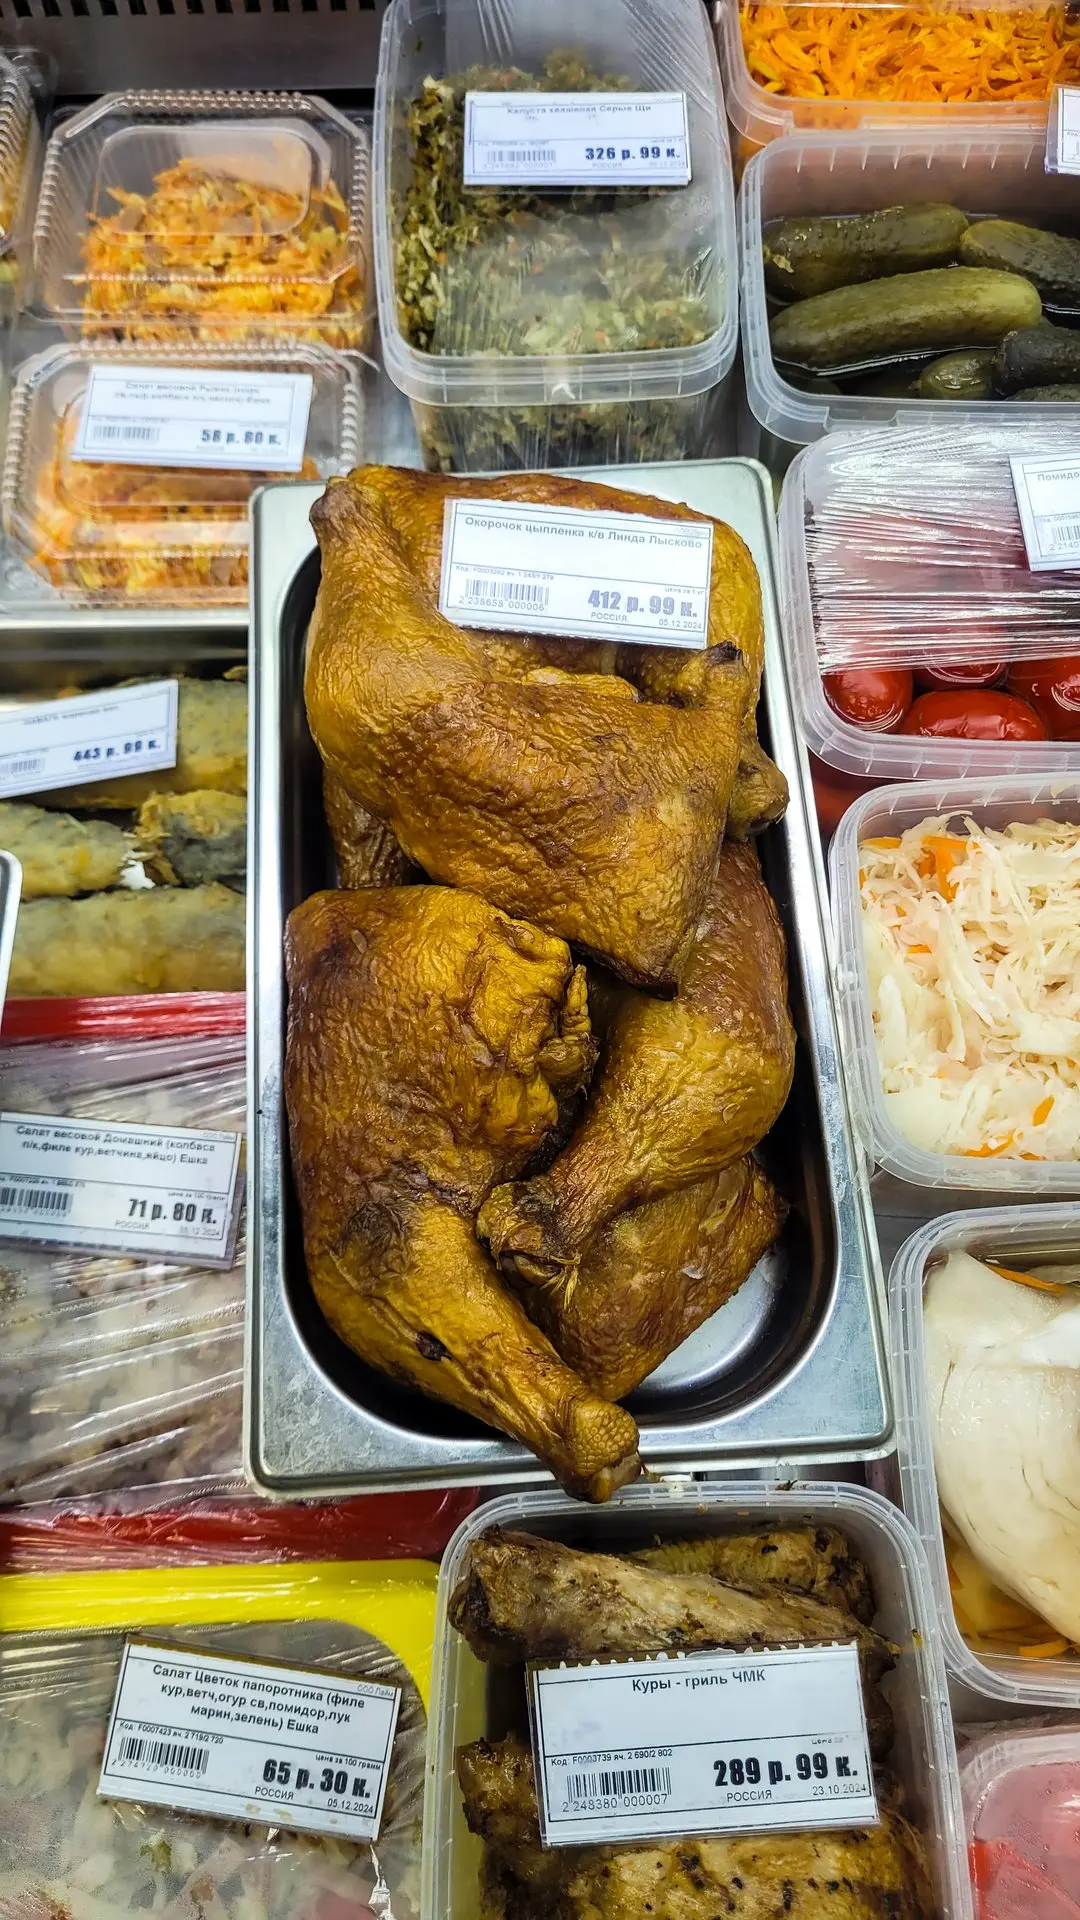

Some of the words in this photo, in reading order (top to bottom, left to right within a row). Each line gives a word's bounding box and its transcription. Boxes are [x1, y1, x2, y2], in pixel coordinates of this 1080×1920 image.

[585, 147, 616, 160] 326
[621, 149, 636, 160] р.
[640, 146, 661, 159] 99
[666, 147, 681, 158] к.
[465, 516, 522, 531] Окорочок
[525, 523, 584, 538] цыпленка
[588, 530, 605, 540] к/в
[608, 531, 645, 544] Линда
[649, 535, 702, 549] Лысково
[459, 596, 465, 604] 2
[588, 590, 621, 610] 412
[626, 596, 644, 613] р.
[649, 595, 674, 616] 99
[680, 601, 697, 618] к.
[591, 611, 628, 622] РОССИЯ
[659, 618, 702, 629] 05.12.2024
[16, 1125, 51, 1137] Салат
[54, 1130, 101, 1142] весовой
[104, 1132, 163, 1147] Домашний
[166, 1139, 216, 1152] (колбаса
[180, 1153, 209, 1165] Ешка
[128, 1198, 148, 1218] 71
[151, 1203, 168, 1221] р.
[173, 1202, 197, 1223] 80
[201, 1208, 218, 1225] к.
[153, 1664, 192, 1680] Салат
[195, 1670, 240, 1688] Цветок
[242, 1680, 323, 1702] папоротника
[326, 1692, 365, 1709] (филе
[632, 1678, 671, 1694] Куры
[685, 1675, 728, 1690] гриль
[732, 1668, 766, 1683] ЧМК
[161, 1683, 247, 1708] кур,ветч,огур
[250, 1699, 351, 1724] св,помидор,лук
[190, 1705, 284, 1731] марин,зелень)
[287, 1718, 319, 1734] Ешка
[315, 1754, 334, 1763] цена
[345, 1758, 357, 1767] 100
[358, 1761, 381, 1770] грамм
[551, 1757, 570, 1767] Код:
[614, 1753, 626, 1761] яч.
[628, 1751, 633, 1760] 2
[658, 1748, 673, 1758] 802
[263, 1759, 292, 1785] 65
[295, 1768, 315, 1790] р.
[320, 1768, 348, 1795] 30
[352, 1777, 371, 1799] к.
[713, 1757, 761, 1787] 289
[768, 1760, 791, 1786] р.
[796, 1752, 828, 1781] 99
[836, 1755, 858, 1778] к.
[255, 1785, 294, 1801] РОССИЯ
[727, 1789, 772, 1803] РОССИЯ
[812, 1783, 867, 1796] 23.10.2024
[327, 1798, 374, 1814] 05.12.2024
[562, 1801, 569, 1813] 2
[573, 1797, 618, 1812] 248380
[623, 1793, 668, 1808] 000007
